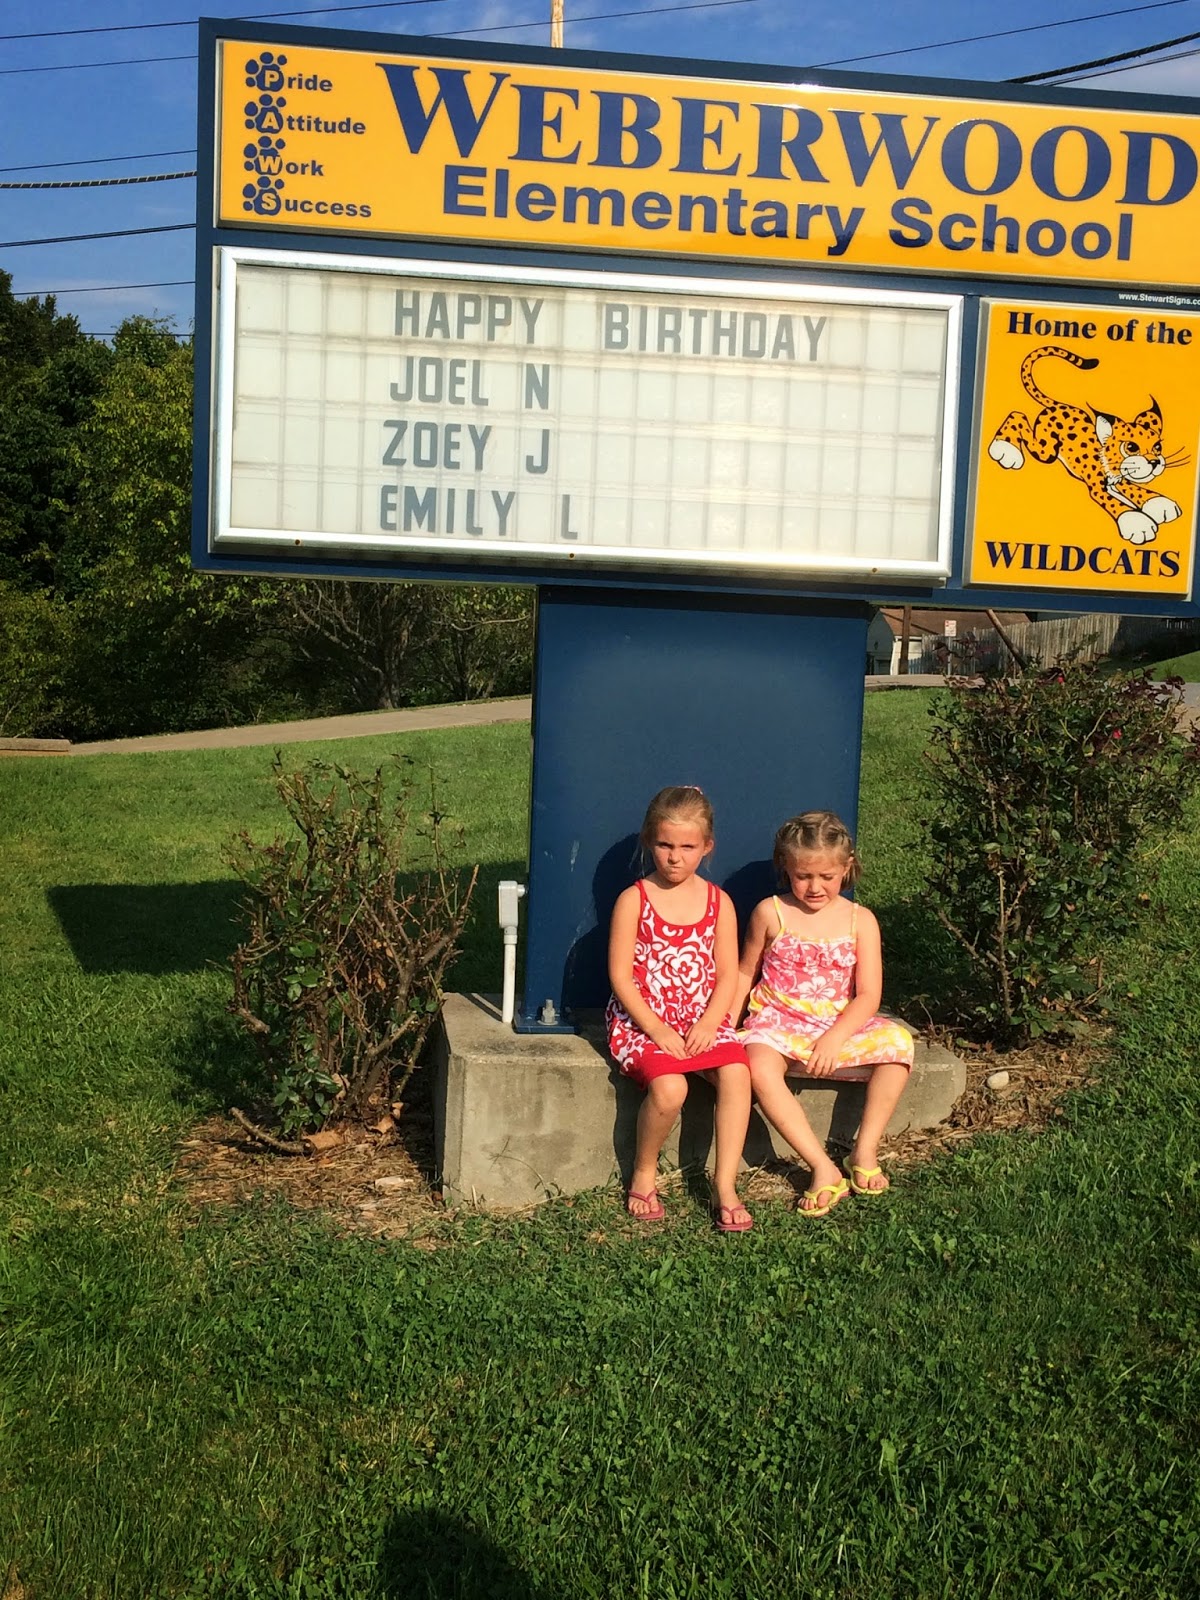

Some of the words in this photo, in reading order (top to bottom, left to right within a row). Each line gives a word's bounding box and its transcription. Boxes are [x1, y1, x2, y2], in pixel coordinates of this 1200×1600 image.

[264, 69, 333, 92] Pride
[261, 113, 366, 135] Attitude
[375, 62, 1199, 206] WEBERWOOD
[257, 153, 324, 177] Work
[261, 192, 372, 218] Success
[443, 164, 866, 256] Elementary
[889, 197, 1134, 261] School
[394, 289, 544, 344] HAPPY
[604, 302, 827, 361] BIRTHDAY
[1007, 311, 1097, 339] Home
[1107, 319, 1139, 343] of
[1146, 321, 1193, 345] the
[390, 355, 489, 406] JOEL
[524, 363, 551, 410] N
[382, 419, 492, 471] ZOEY
[525, 428, 550, 474] J
[379, 484, 516, 536] EMILY
[560, 493, 578, 540] L
[984, 541, 1180, 578] WILDCATS
